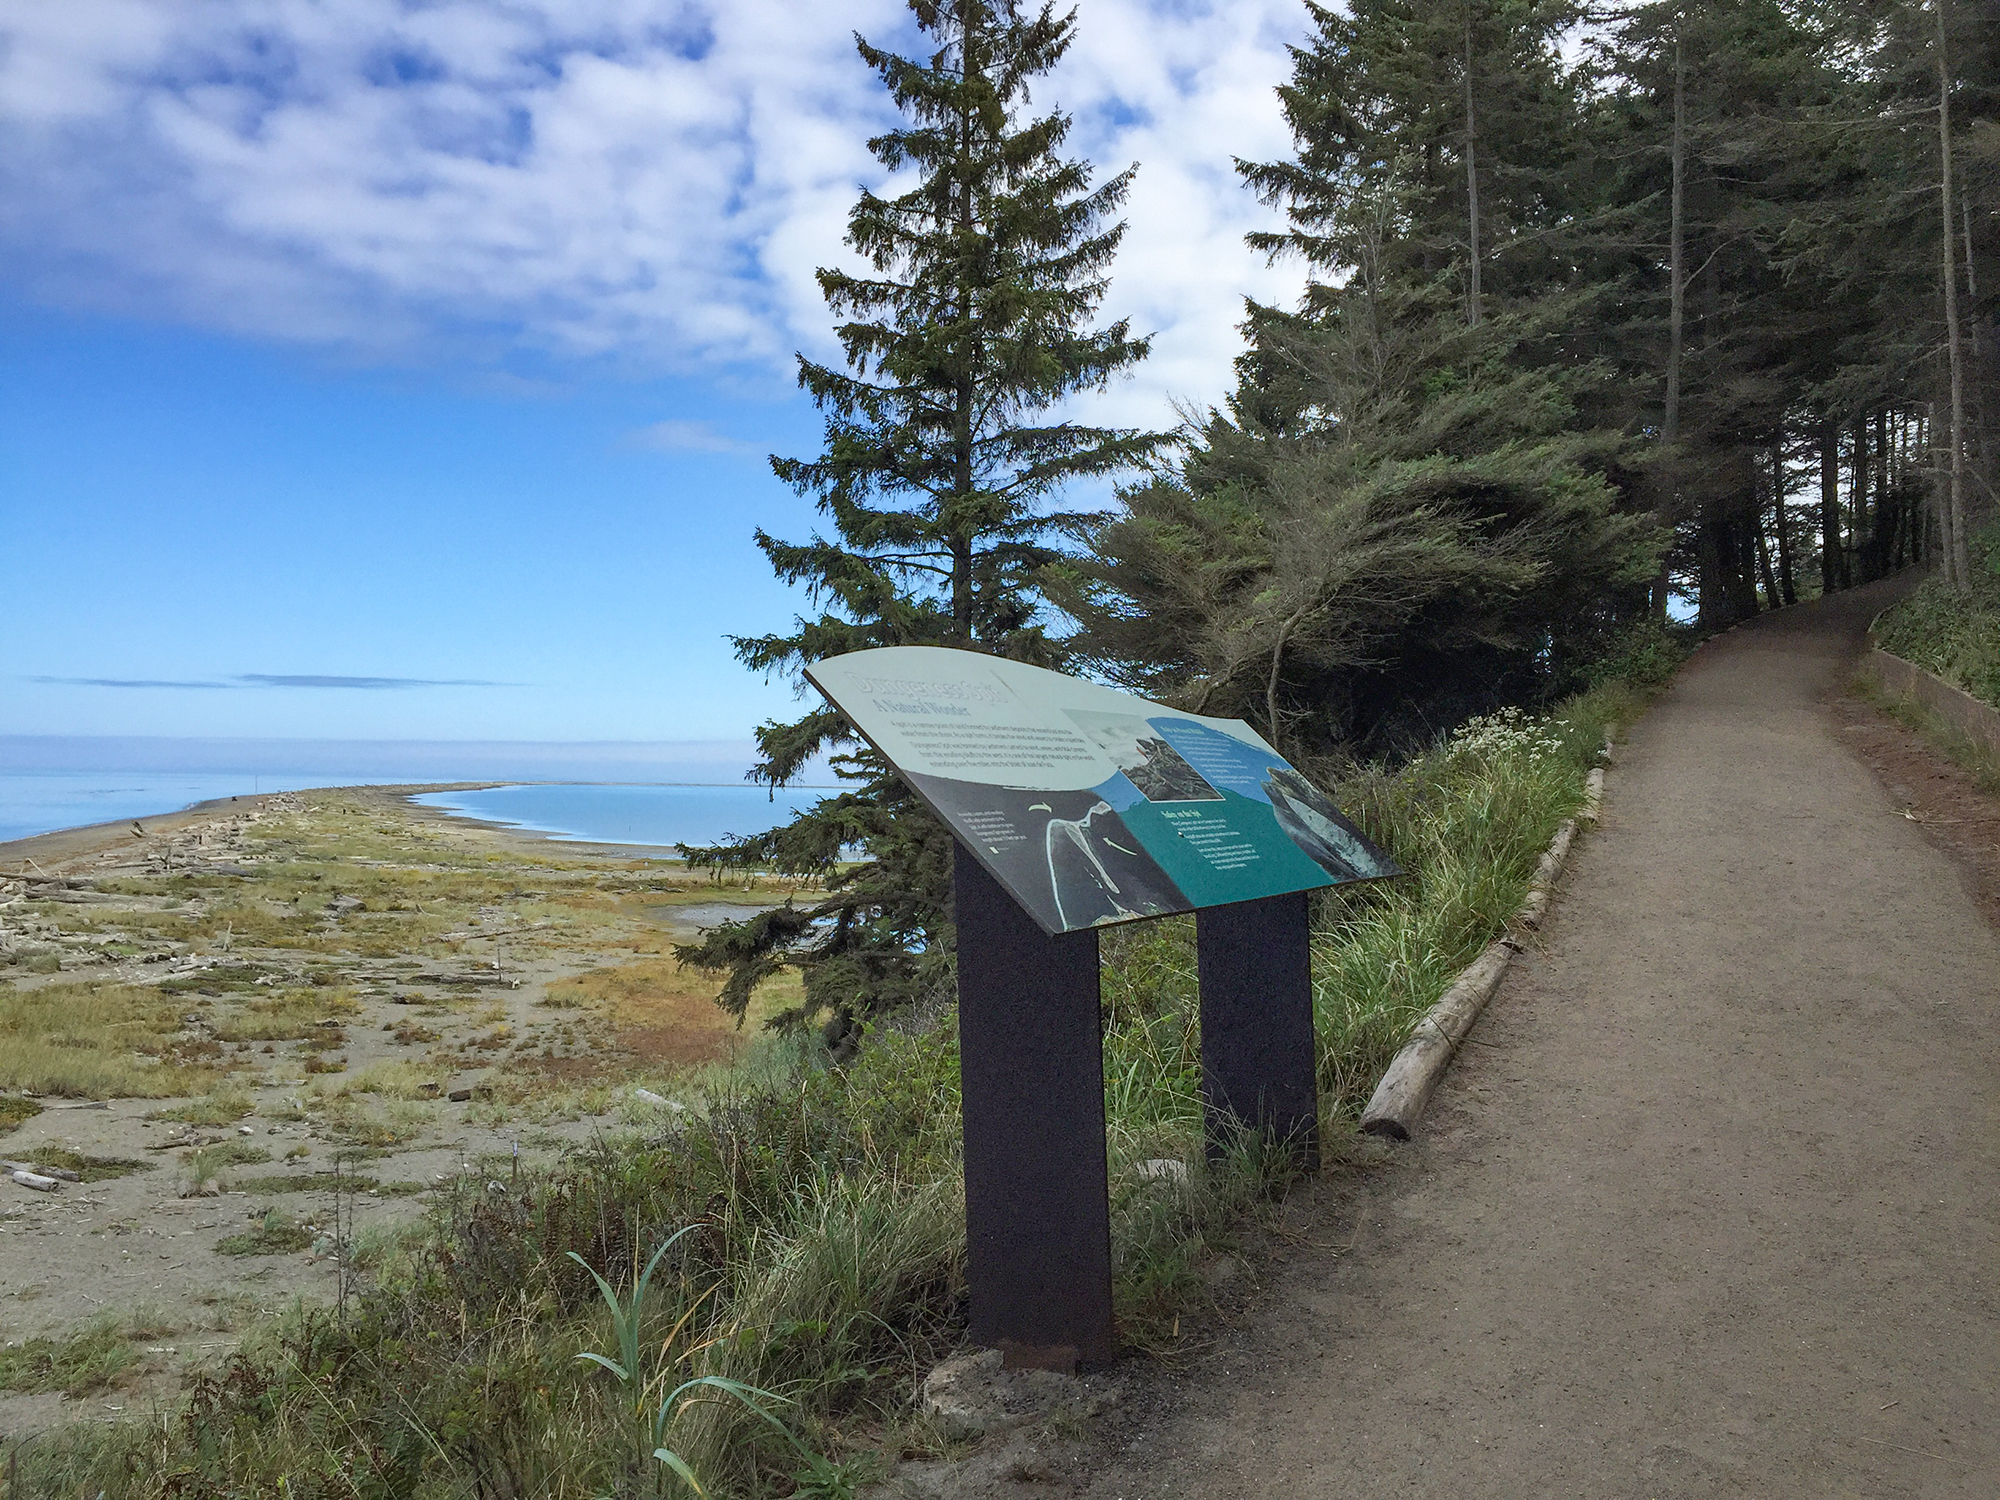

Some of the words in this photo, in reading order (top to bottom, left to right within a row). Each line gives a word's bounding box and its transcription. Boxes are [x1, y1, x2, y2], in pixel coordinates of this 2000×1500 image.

[844, 671, 970, 701] Dungeness
[960, 680, 1008, 706] Spit
[872, 699, 889, 713] A
[881, 699, 932, 714] Natural
[924, 702, 971, 716] Wonder
